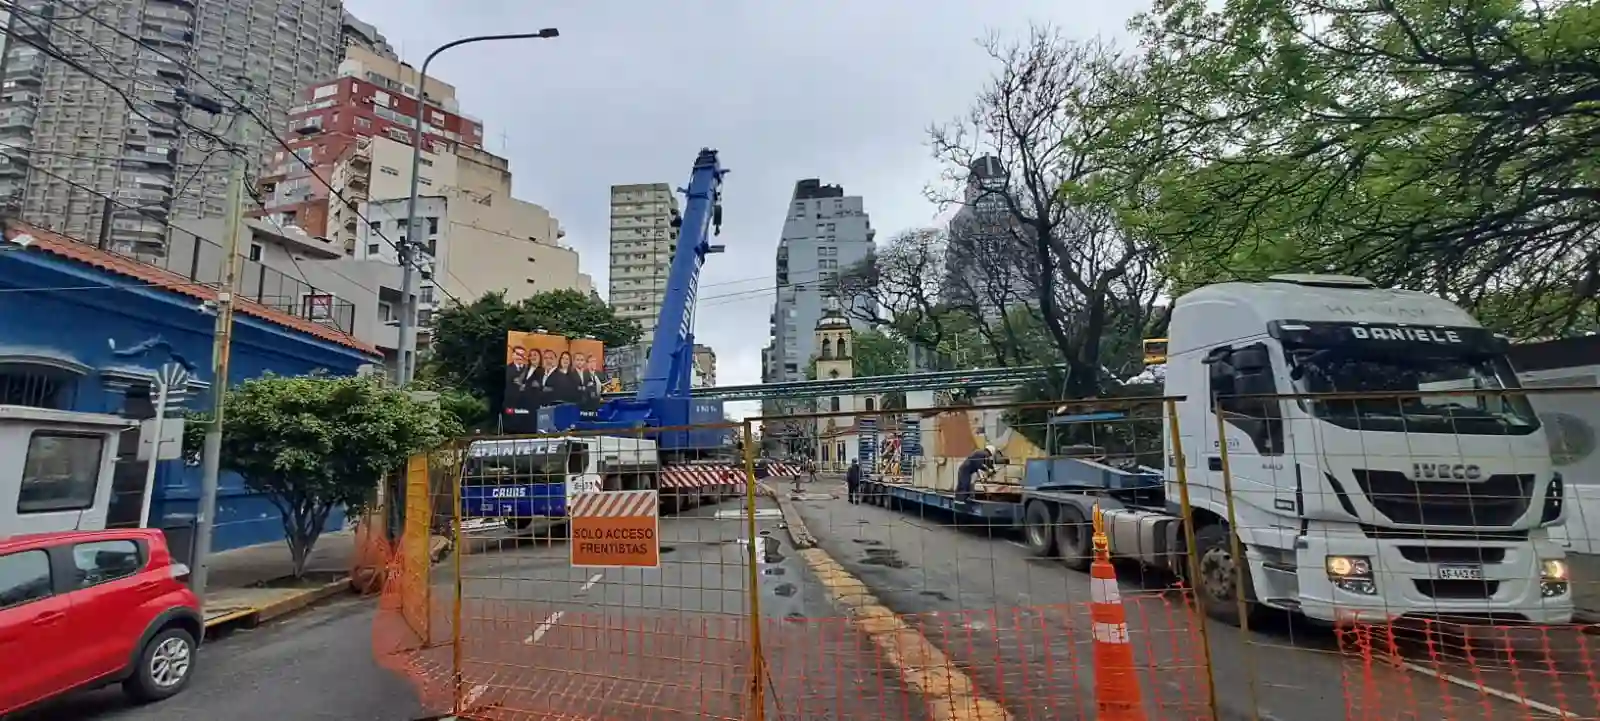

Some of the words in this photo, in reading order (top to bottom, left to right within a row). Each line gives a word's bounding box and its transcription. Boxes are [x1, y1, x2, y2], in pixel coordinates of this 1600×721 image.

[1351, 327, 1462, 344] DANIELE
[474, 443, 559, 458] DANIELE
[1413, 463, 1481, 480] IVECO
[573, 527, 603, 540] SOLO
[605, 527, 654, 540] ACCESO
[580, 542, 648, 555] FRENTISTAS
